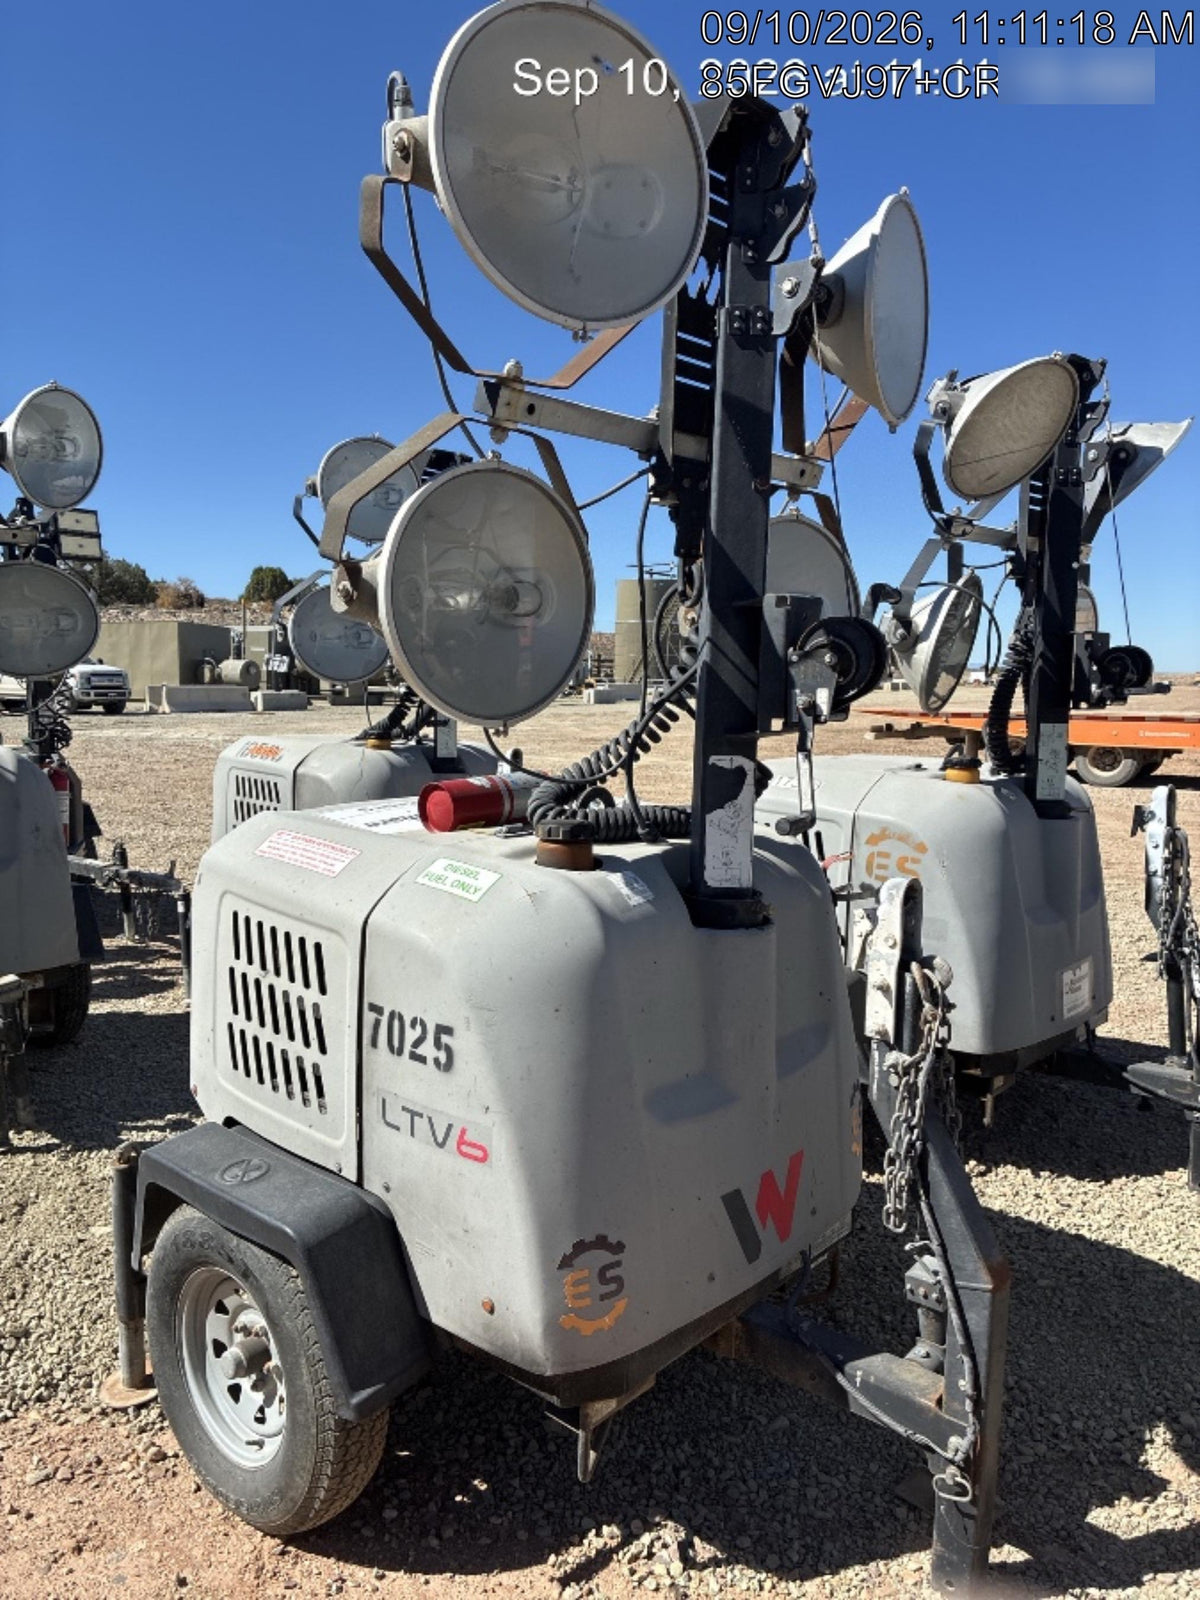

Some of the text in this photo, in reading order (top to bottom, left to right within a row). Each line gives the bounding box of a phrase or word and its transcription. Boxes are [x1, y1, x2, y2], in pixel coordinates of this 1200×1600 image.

[422, 870, 482, 896] FUEL ONLY
[443, 862, 481, 881] DIESEL
[367, 1001, 455, 1074] 7025
[381, 1096, 491, 1165] LTV6
